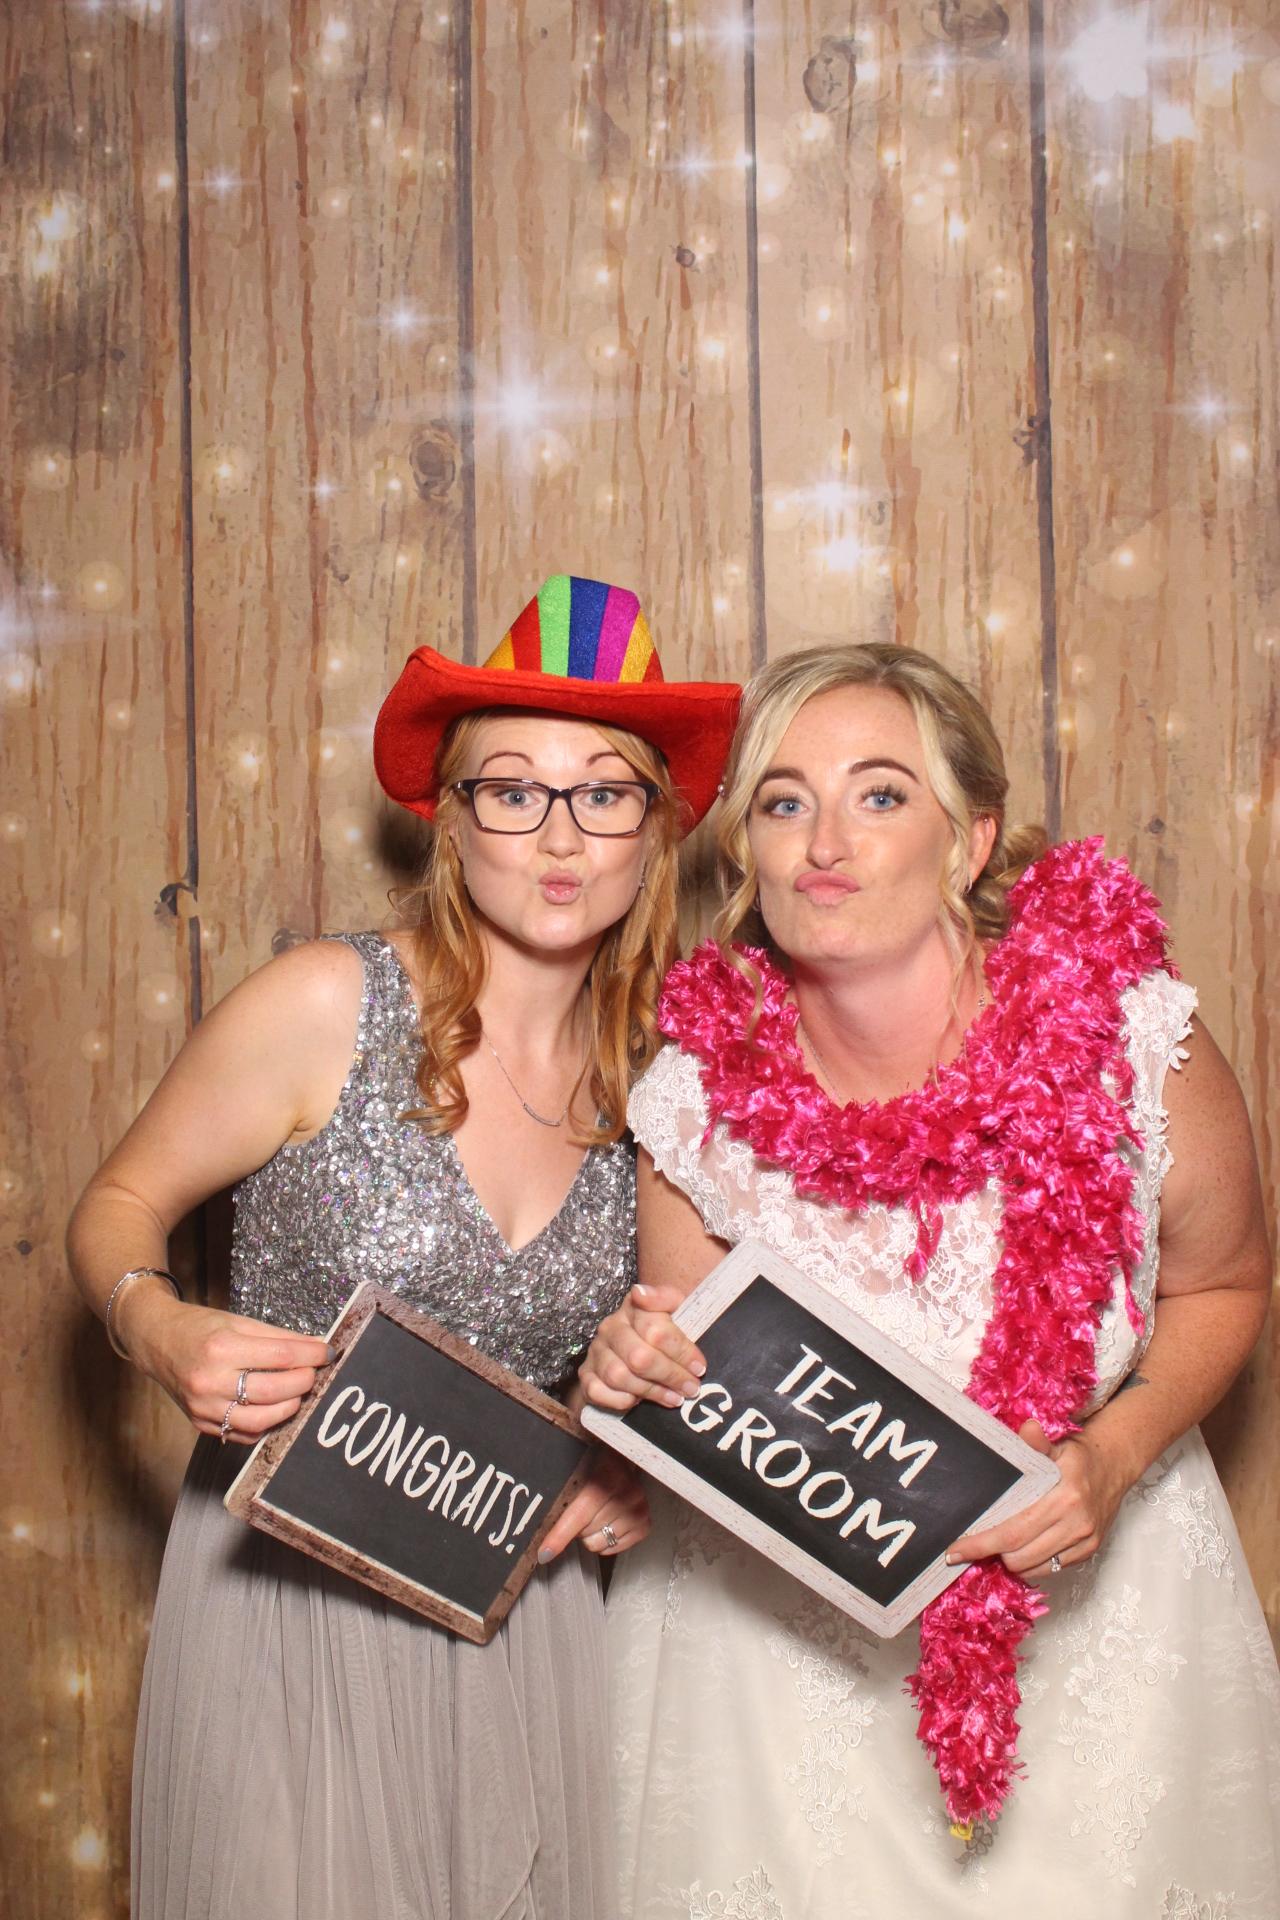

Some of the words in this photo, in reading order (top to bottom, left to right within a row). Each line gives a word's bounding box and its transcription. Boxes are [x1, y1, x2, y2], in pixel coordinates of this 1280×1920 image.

[316, 1385, 544, 1555] CONGRATS!
[680, 1382, 917, 1568] GROOM
[774, 1343, 939, 1489] TEAM
